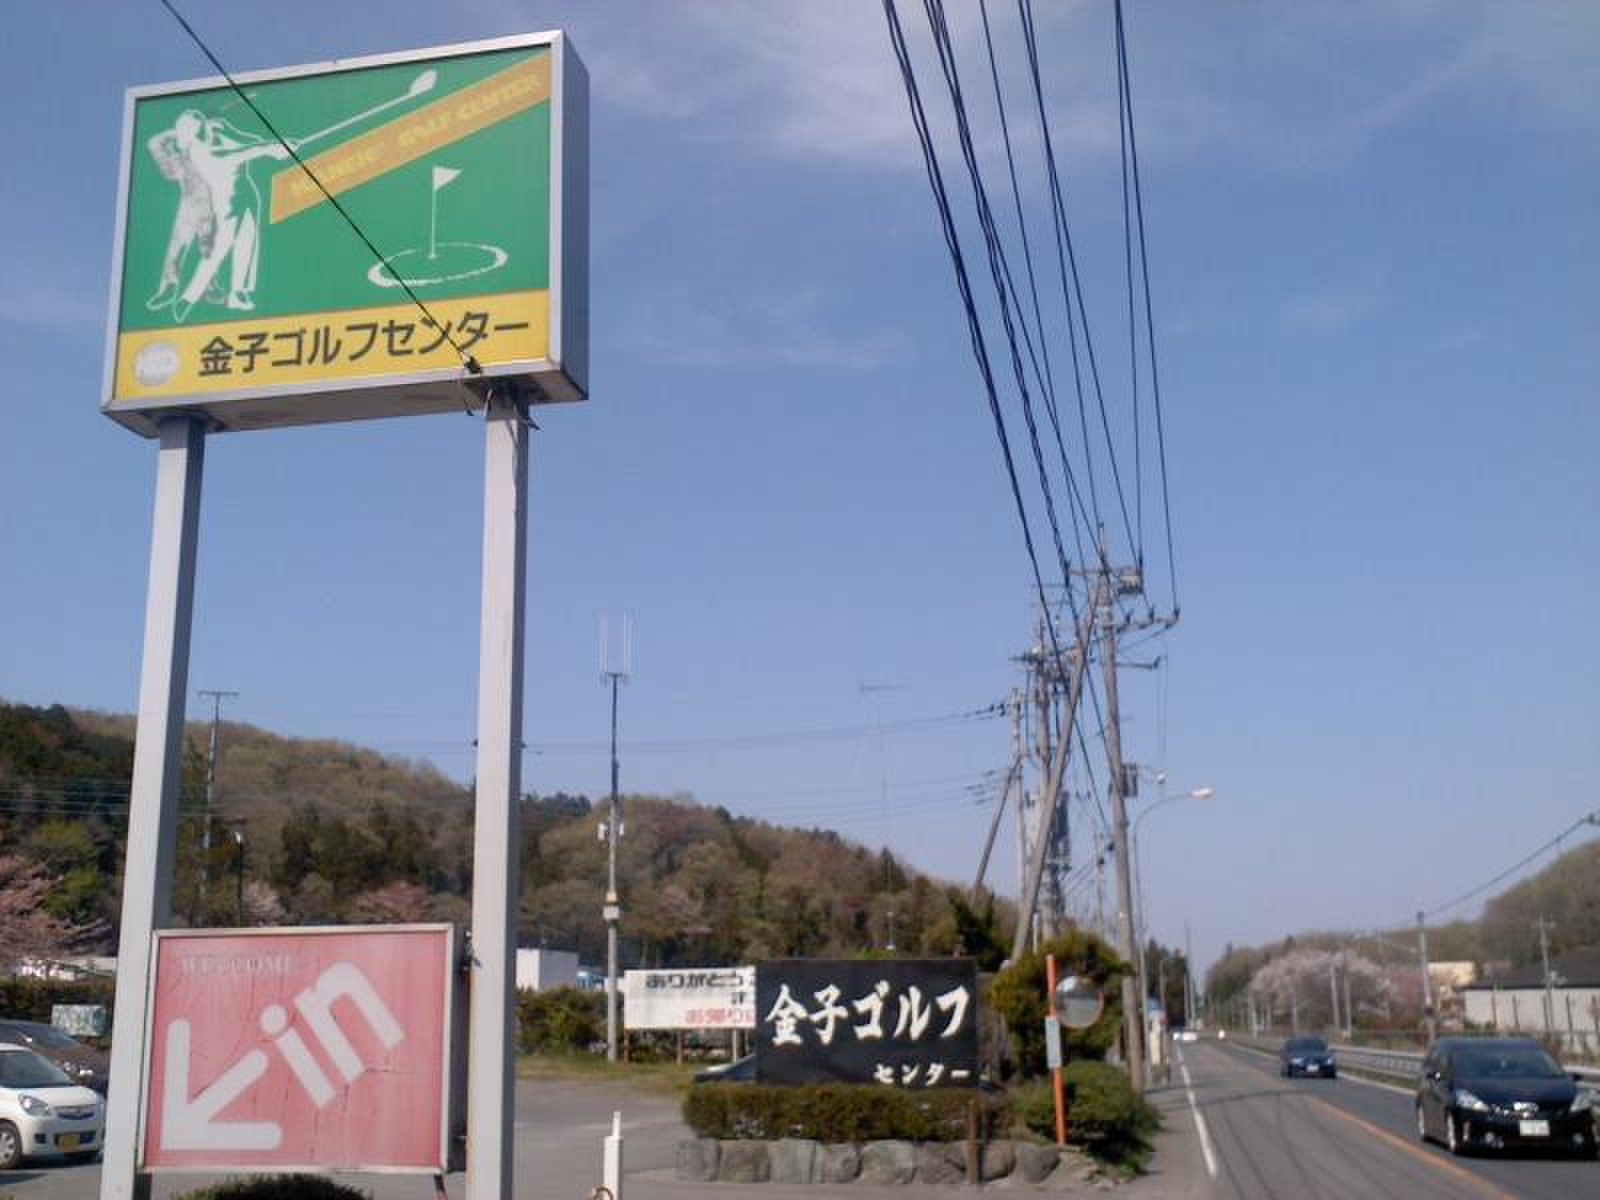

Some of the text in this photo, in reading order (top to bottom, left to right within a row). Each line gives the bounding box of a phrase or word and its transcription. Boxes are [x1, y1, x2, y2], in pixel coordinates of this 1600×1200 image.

[198, 310, 530, 378] 金子ゴルフセンター
[258, 959, 406, 1109] in
[764, 979, 970, 1046] 金子ゴルフ
[872, 1062, 970, 1087] センター
